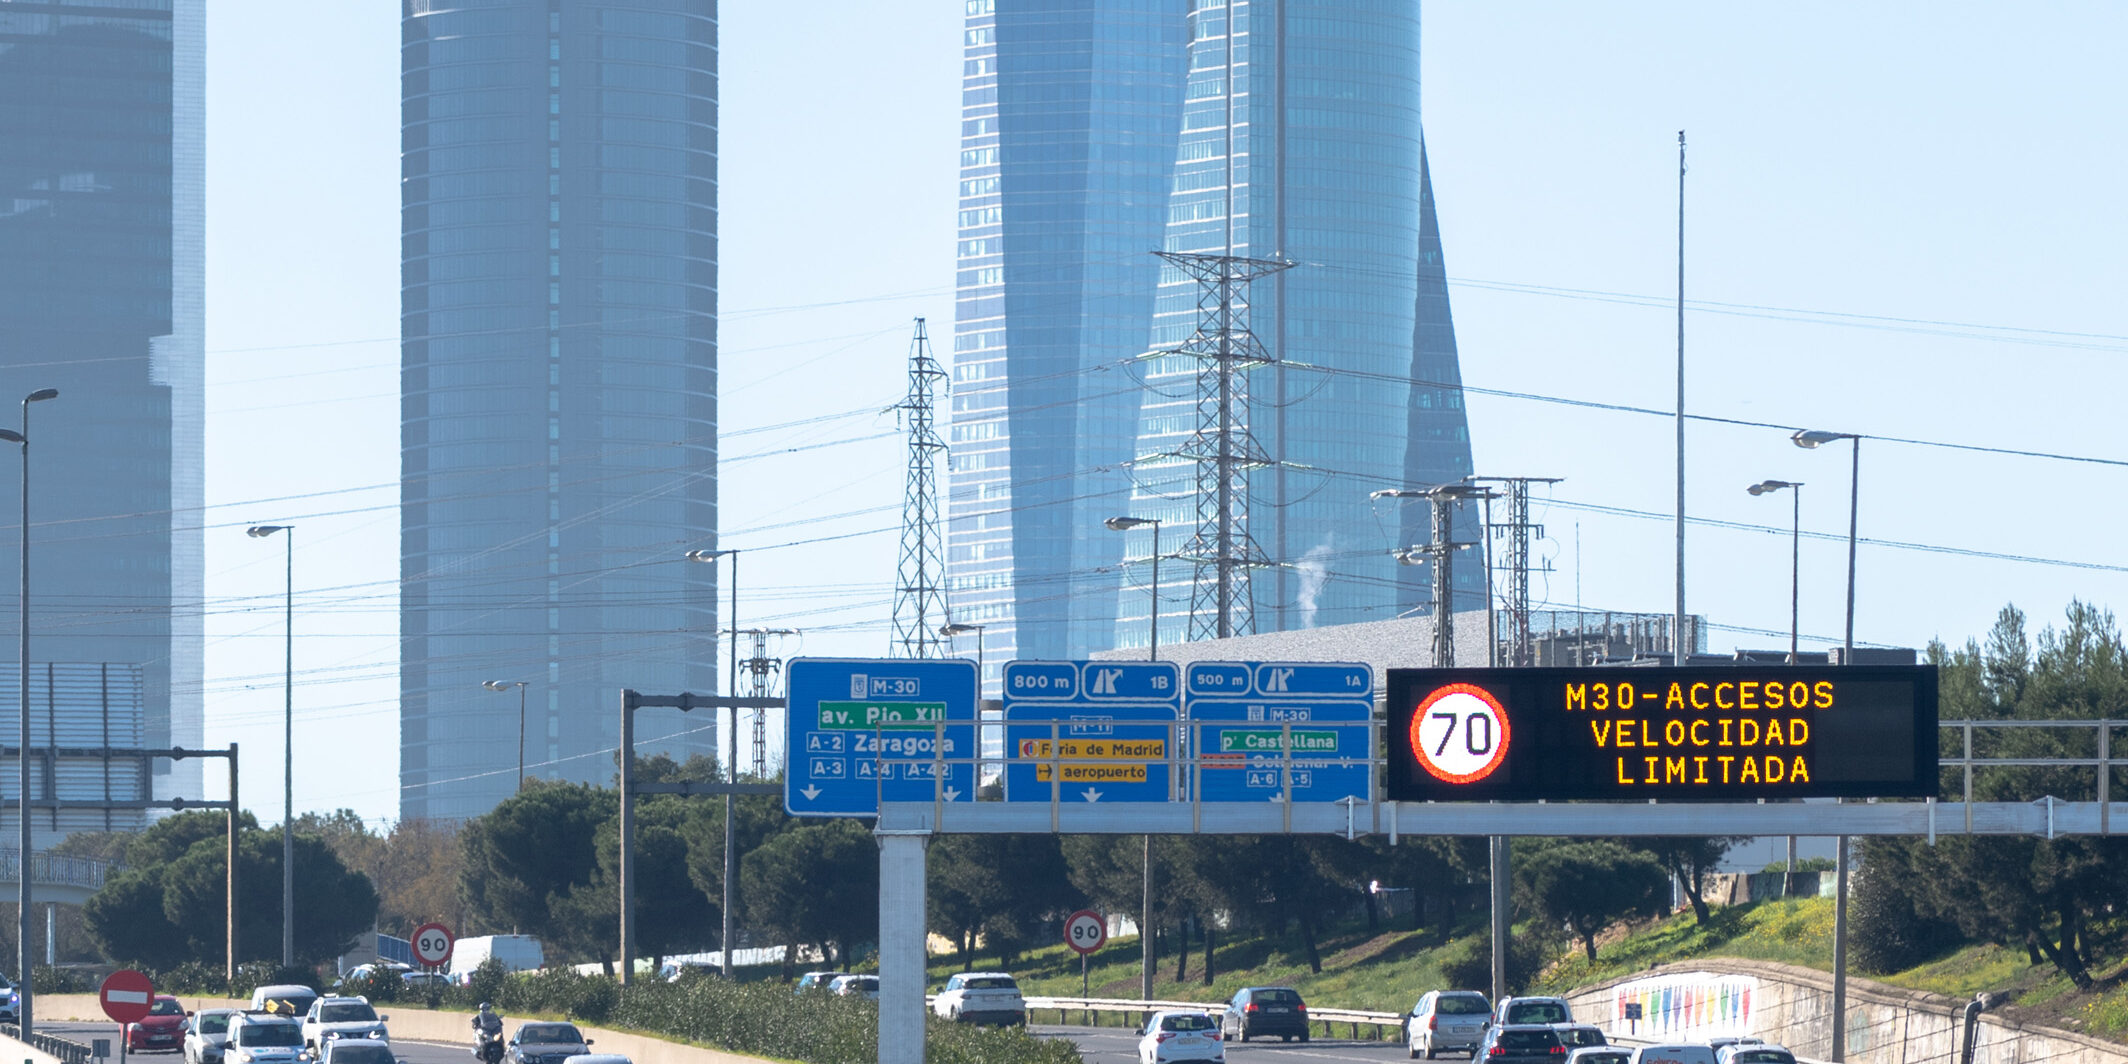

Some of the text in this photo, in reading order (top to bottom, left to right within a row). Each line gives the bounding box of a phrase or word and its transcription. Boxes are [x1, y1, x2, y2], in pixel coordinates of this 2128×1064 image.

[873, 680, 916, 694] M-30
[1014, 675, 1069, 689] 800 m
[1150, 676, 1169, 689] 1B
[1197, 674, 1243, 686] 500 m
[1345, 675, 1361, 687] 1A
[1566, 681, 1833, 711] M30-ACCESOS
[821, 706, 943, 725] av. Pio XII
[1273, 710, 1308, 722] M-30
[1432, 712, 1491, 756] 70
[1591, 719, 1809, 748] VELOCIDAD
[810, 735, 842, 750] A-2
[1041, 743, 1163, 756] Fria de Madrid
[814, 761, 842, 775] A-3
[860, 762, 891, 776] A-4
[1064, 766, 1146, 779] aeropuerto
[1617, 756, 1809, 783] LIMITADA
[1250, 773, 1274, 784] A-6
[1074, 925, 1098, 940] 90
[420, 938, 446, 952] 90
